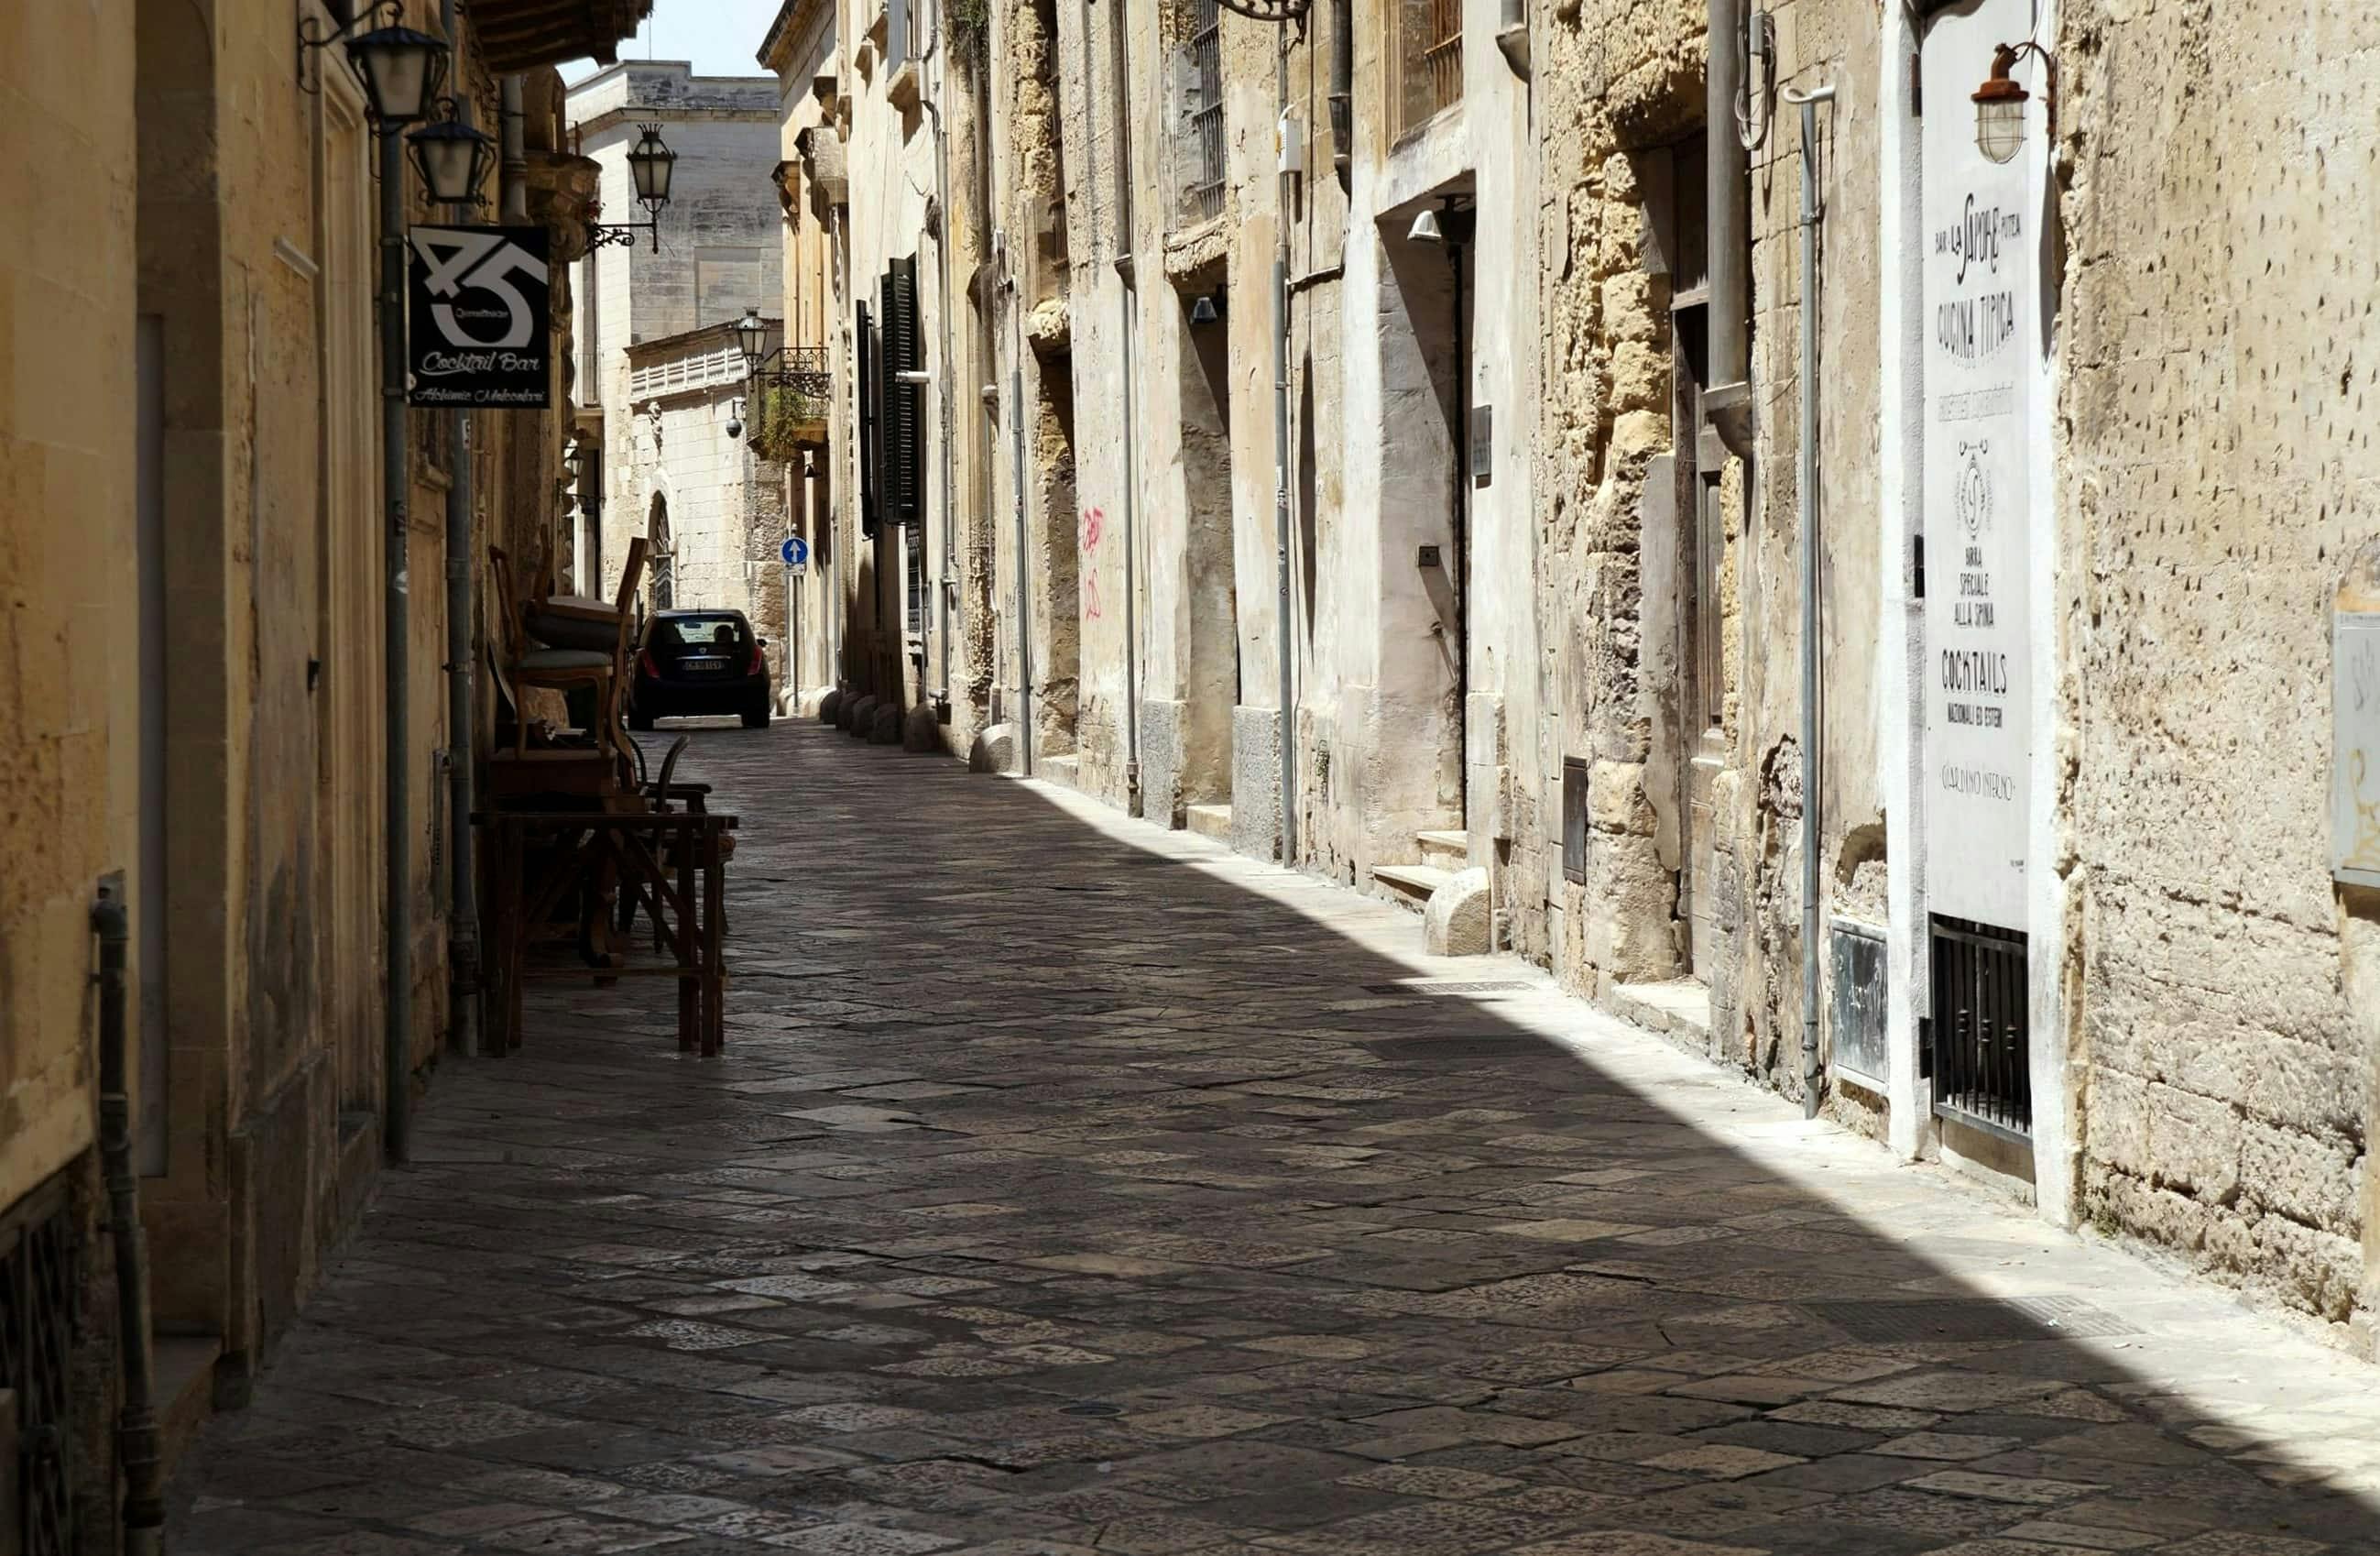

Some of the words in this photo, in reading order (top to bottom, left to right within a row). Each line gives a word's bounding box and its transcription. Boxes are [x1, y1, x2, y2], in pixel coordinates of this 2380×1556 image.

[1935, 230, 1947, 256] BAR
[1950, 225, 1962, 255] LA
[1957, 192, 1999, 285] SAPORE
[409, 226, 548, 347] 45
[1938, 298, 1974, 358] CUCINA
[1980, 290, 2014, 356] TIPICA
[419, 350, 496, 376] Cocktail
[499, 352, 540, 372] Bar
[1960, 573, 1989, 596] SPECIALE
[1955, 601, 1971, 627] ALLA
[1975, 602, 1993, 628] SPINA
[1942, 648, 2006, 695] COCKTAILS
[1976, 706, 1982, 726] ED
[1942, 764, 1981, 794] GIARDINO
[1982, 772, 2013, 802] INTERNO
